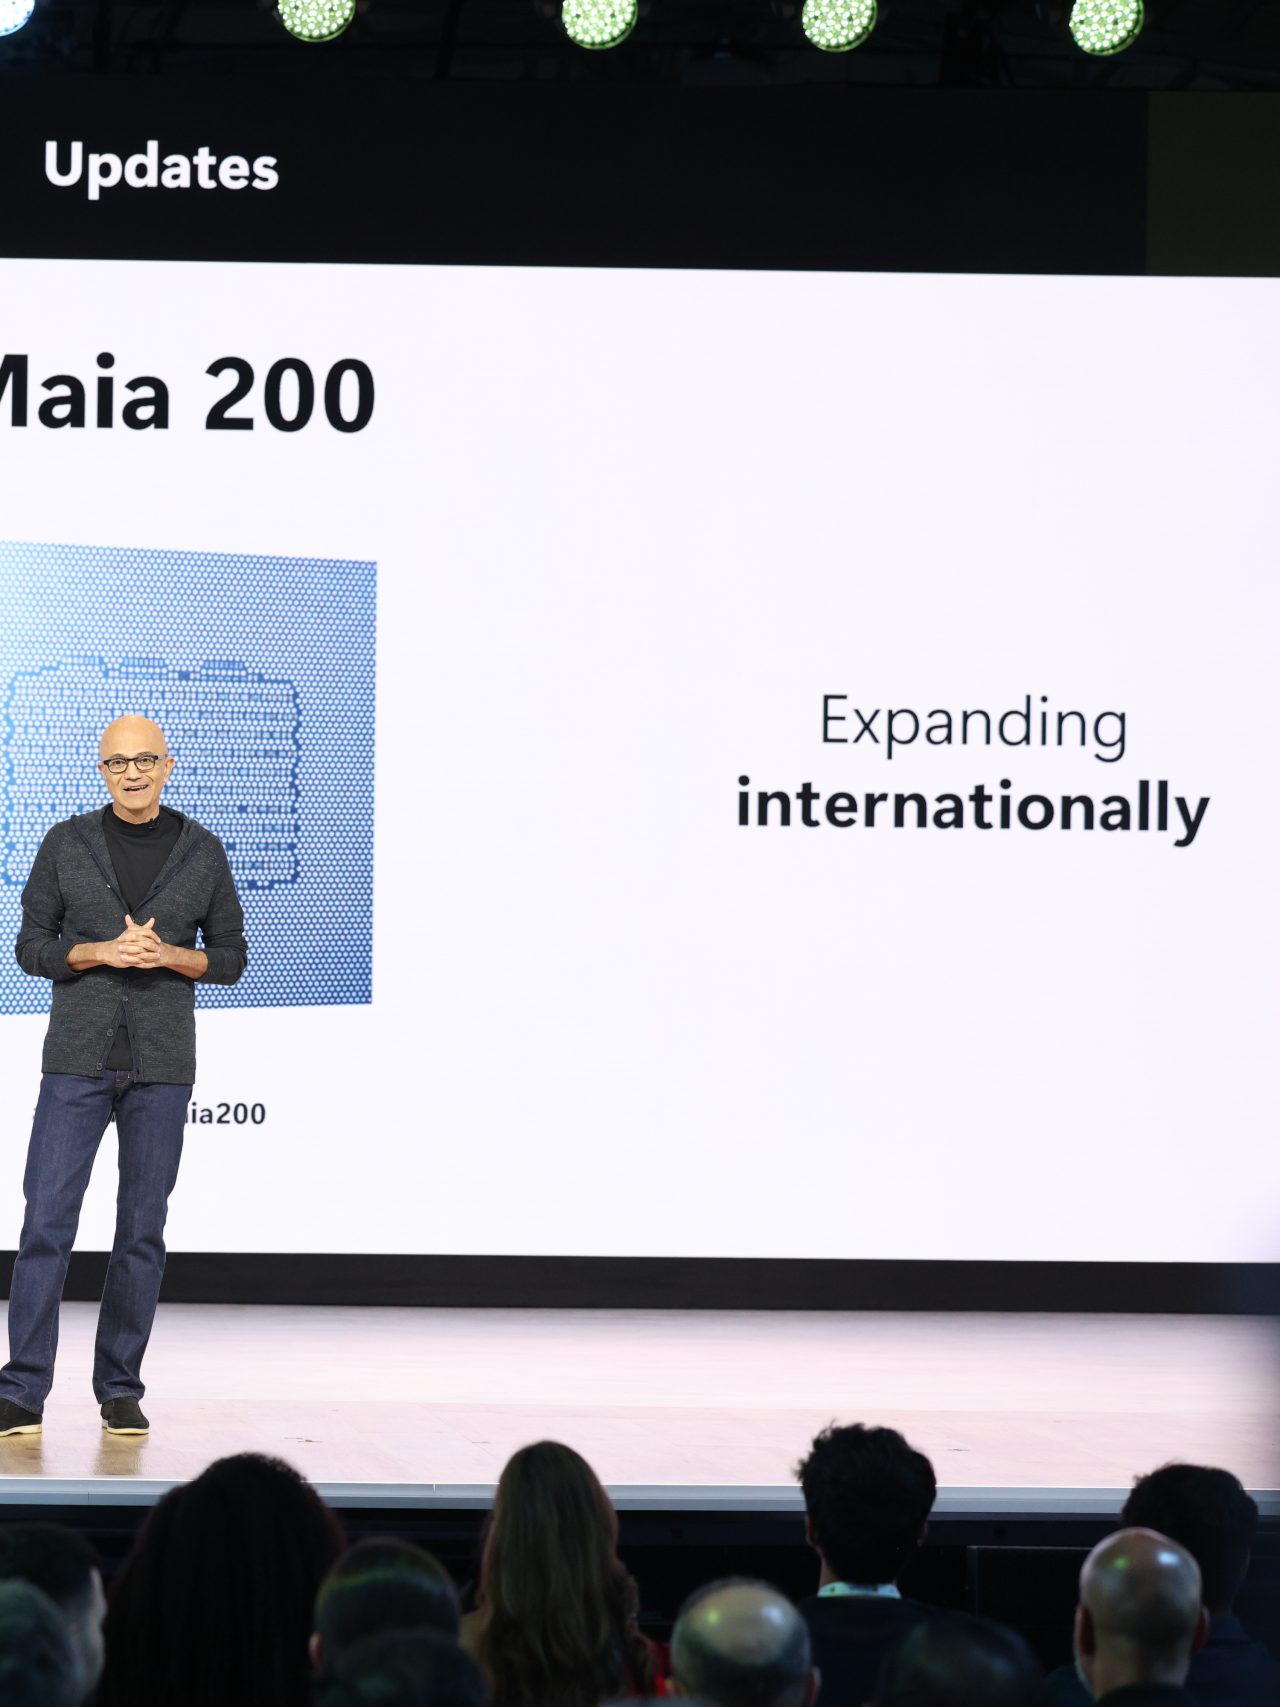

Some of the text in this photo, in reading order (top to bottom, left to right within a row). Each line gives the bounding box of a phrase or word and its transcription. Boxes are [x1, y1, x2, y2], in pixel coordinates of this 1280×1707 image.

[44, 139, 279, 201] Updates
[205, 356, 375, 434] 200
[822, 694, 1126, 764] Expanding
[737, 774, 1211, 848] internationally
[186, 1102, 266, 1125] ia200
